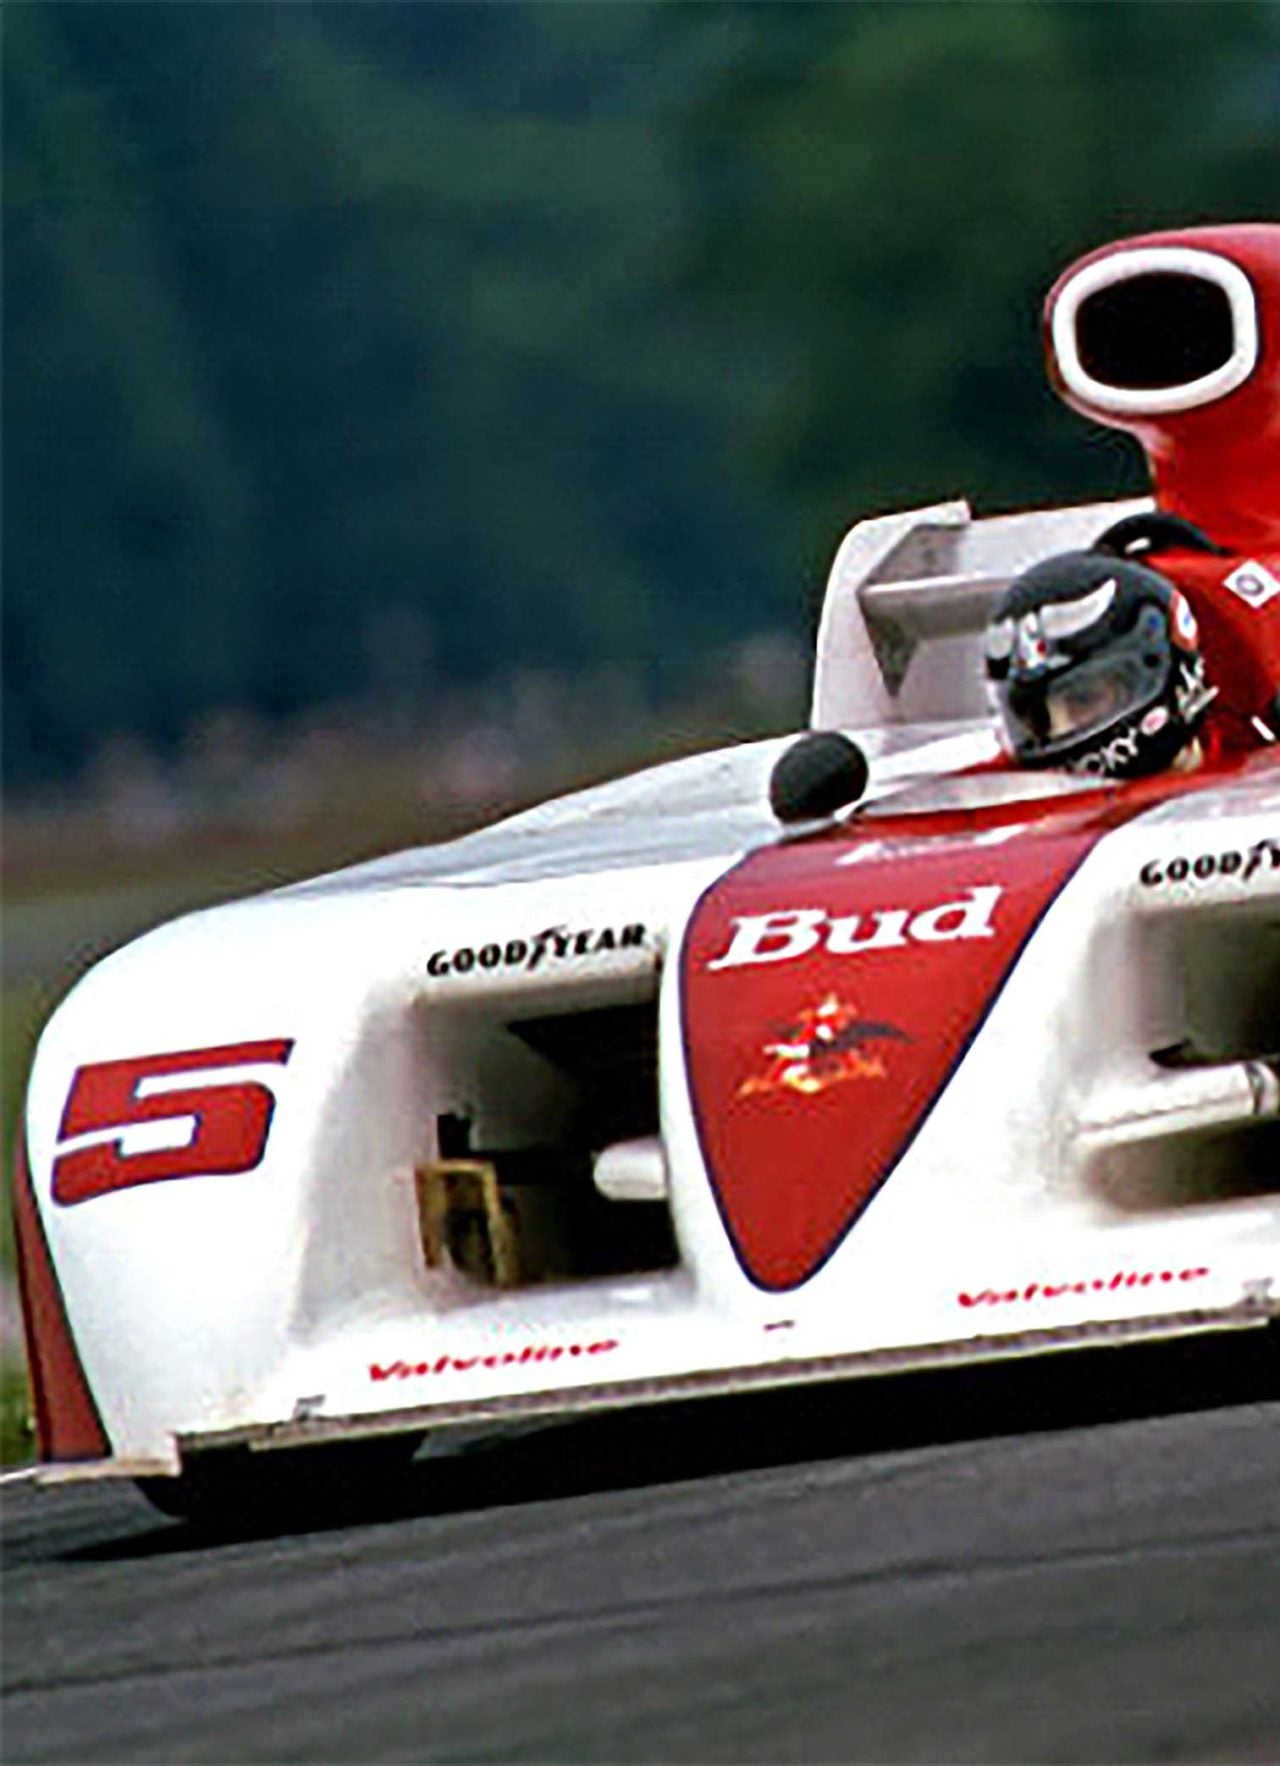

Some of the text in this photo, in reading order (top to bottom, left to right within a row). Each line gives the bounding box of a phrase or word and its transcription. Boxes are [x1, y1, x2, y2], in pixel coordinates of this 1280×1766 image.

[426, 923, 645, 977] GOODYEAR
[705, 884, 1003, 971] Bud
[51, 1038, 296, 1207] 5
